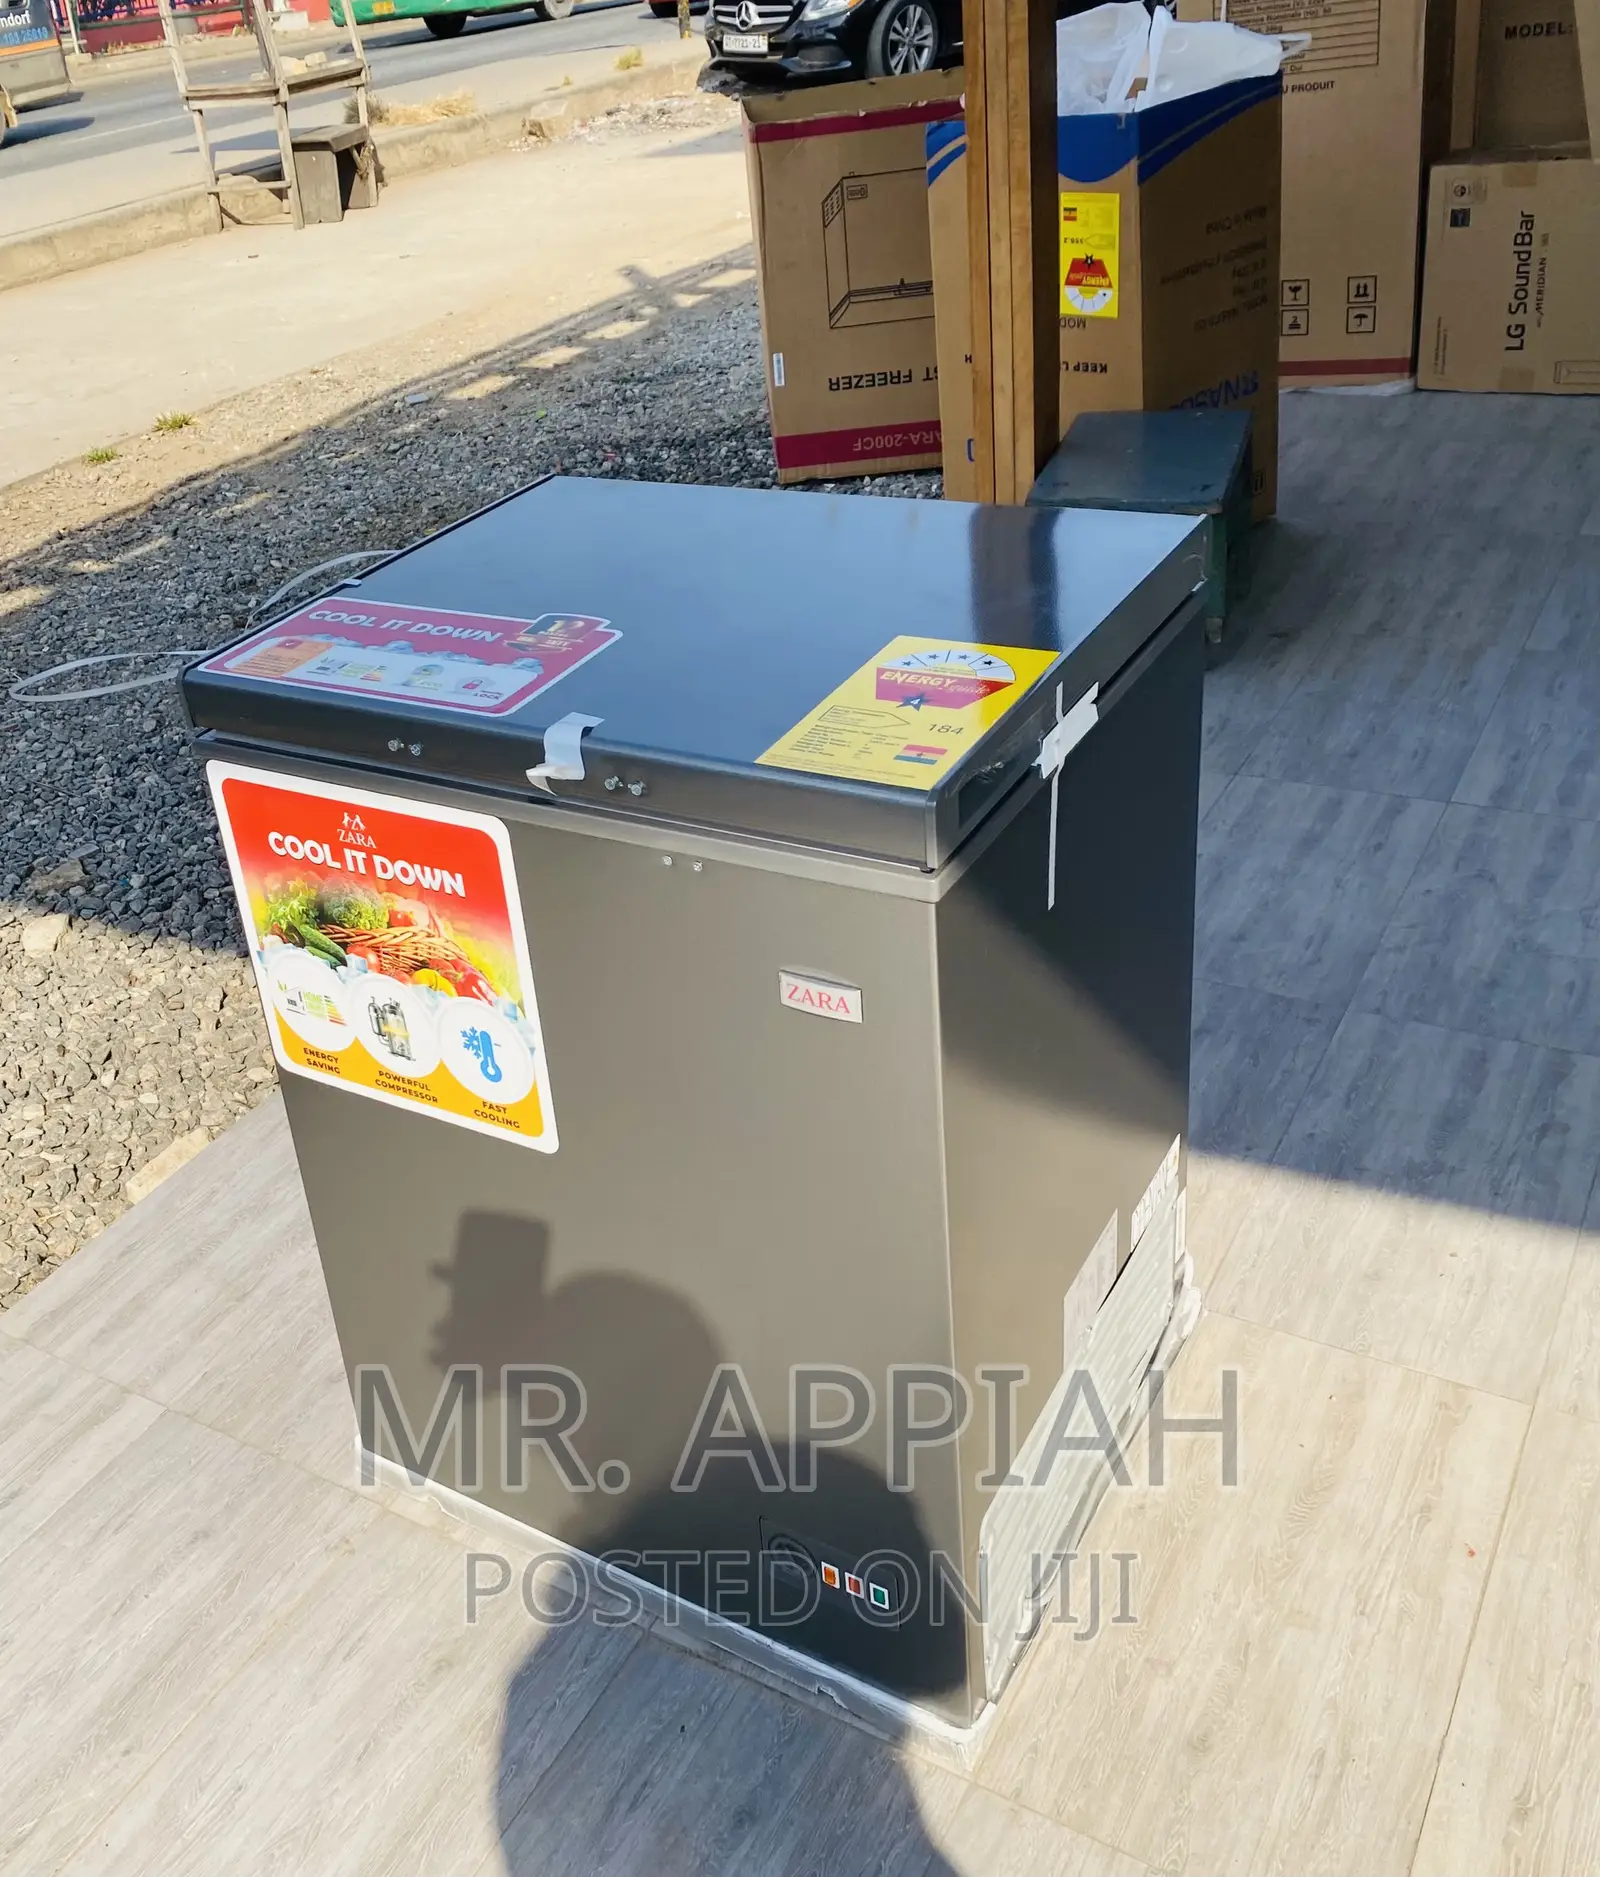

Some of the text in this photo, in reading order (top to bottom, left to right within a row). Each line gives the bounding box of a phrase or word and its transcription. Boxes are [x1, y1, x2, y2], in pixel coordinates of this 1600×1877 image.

[1504, 21, 1574, 40] MODEL:
[1291, 81, 1335, 93] PRODUIT
[1504, 323, 1526, 351] LG
[1073, 361, 1108, 374] KEEP
[828, 368, 913, 392] FREEZER
[308, 610, 377, 627] COOL
[380, 619, 413, 630] IT
[408, 622, 504, 643] DOWN
[880, 670, 957, 688] ENERGY
[928, 723, 964, 735] 184
[336, 828, 377, 849] ZARA
[267, 831, 466, 898] COOL IT DOWN
[786, 983, 850, 1014] ZARA
[303, 1047, 339, 1064] ENERGY
[306, 1058, 341, 1075] SAVING
[378, 1070, 431, 1091] POWERFUL
[375, 1078, 438, 1104] COMPRESSOR
[482, 1100, 507, 1114] FAST
[474, 1109, 520, 1128] COOLING
